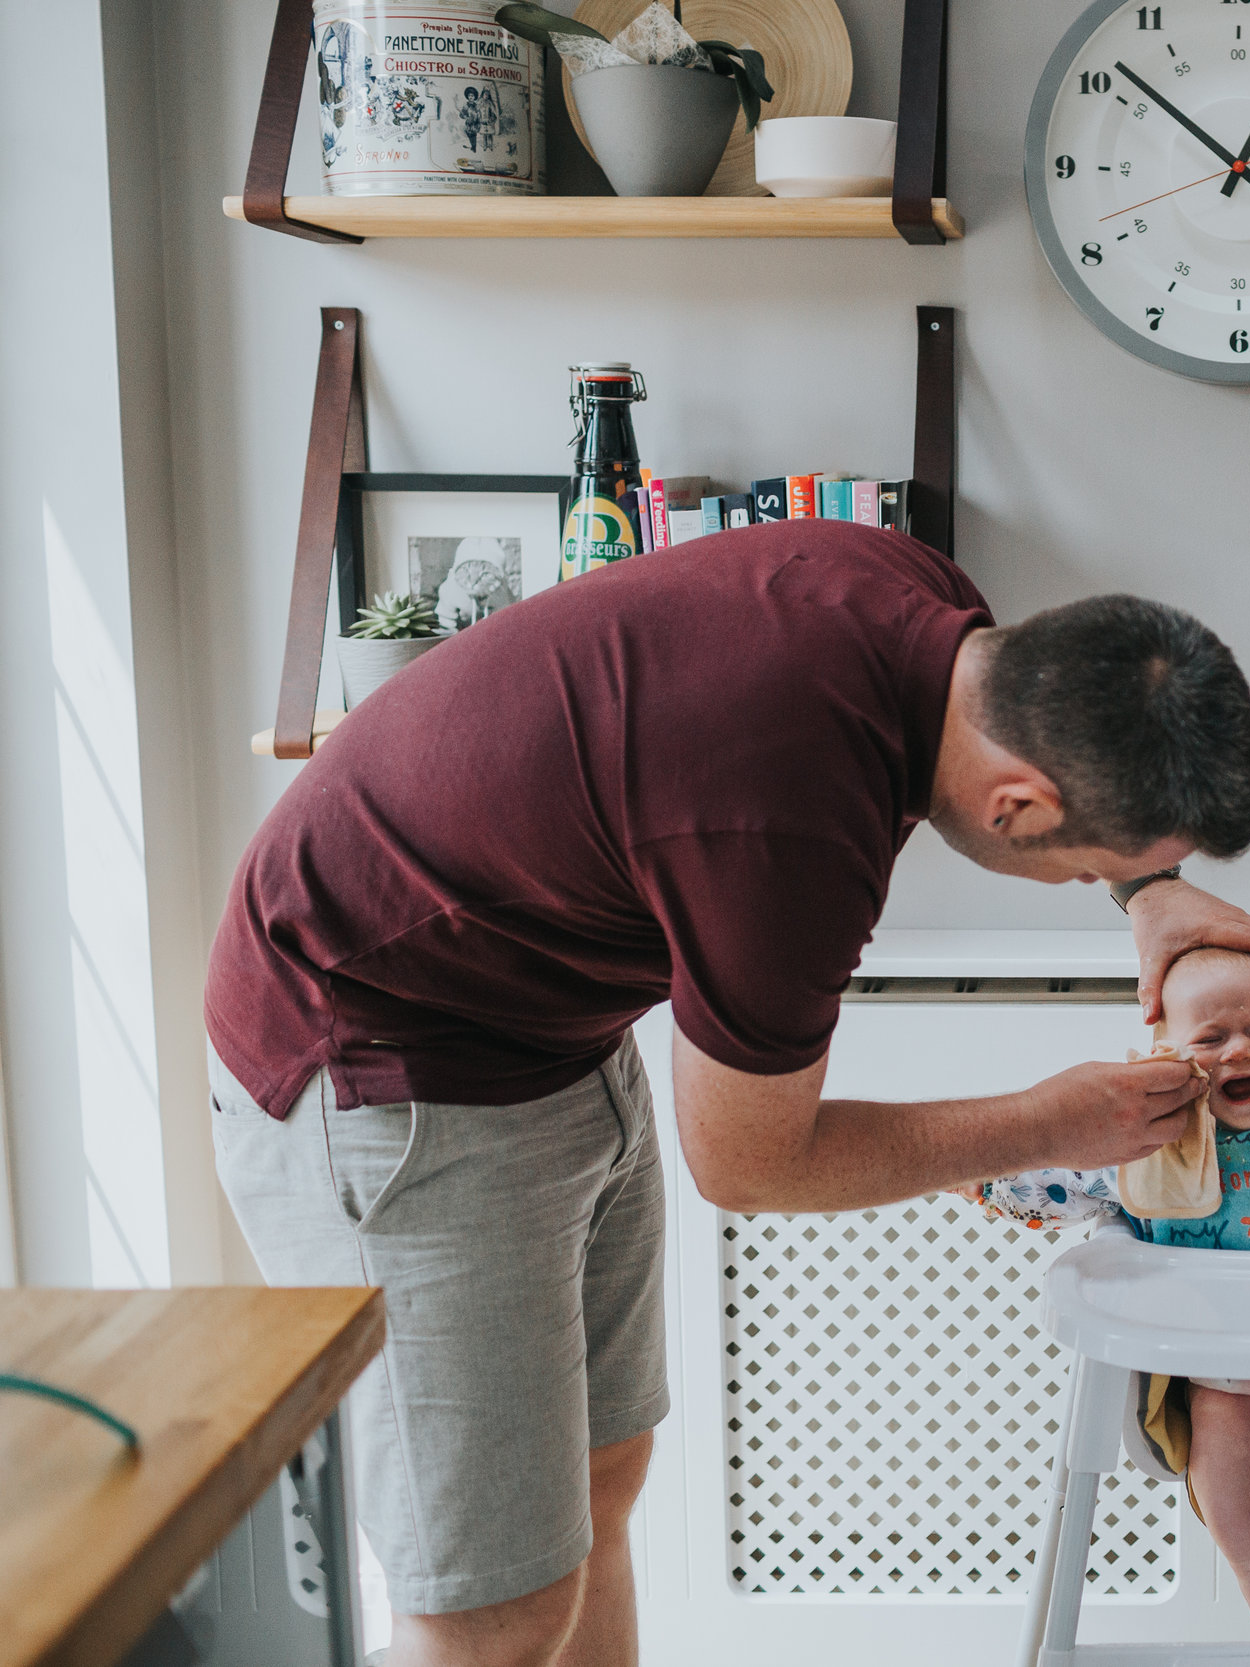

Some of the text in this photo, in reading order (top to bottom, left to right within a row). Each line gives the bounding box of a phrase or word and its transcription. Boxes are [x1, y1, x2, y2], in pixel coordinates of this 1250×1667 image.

[1136, 6, 1164, 30] 11
[385, 36, 519, 61] PANETTONE TIRAMISÙ
[1230, 49, 1246, 60] 00
[384, 57, 454, 74] CHIOSTRO
[468, 61, 522, 82] SARONNO
[1174, 61, 1191, 77] 55
[1078, 71, 1111, 94] 10
[1133, 103, 1148, 120] 50
[1055, 155, 1075, 179] 9
[1120, 161, 1131, 177] 45
[1134, 218, 1148, 234] 40
[1081, 242, 1103, 266] 8
[1174, 261, 1191, 276] 35
[1230, 278, 1246, 289] 30
[1146, 307, 1164, 331] 7
[1229, 329, 1249, 353] 6
[860, 493, 872, 526] FEA
[654, 502, 666, 547] Feeding
[1170, 1219, 1229, 1250] my
